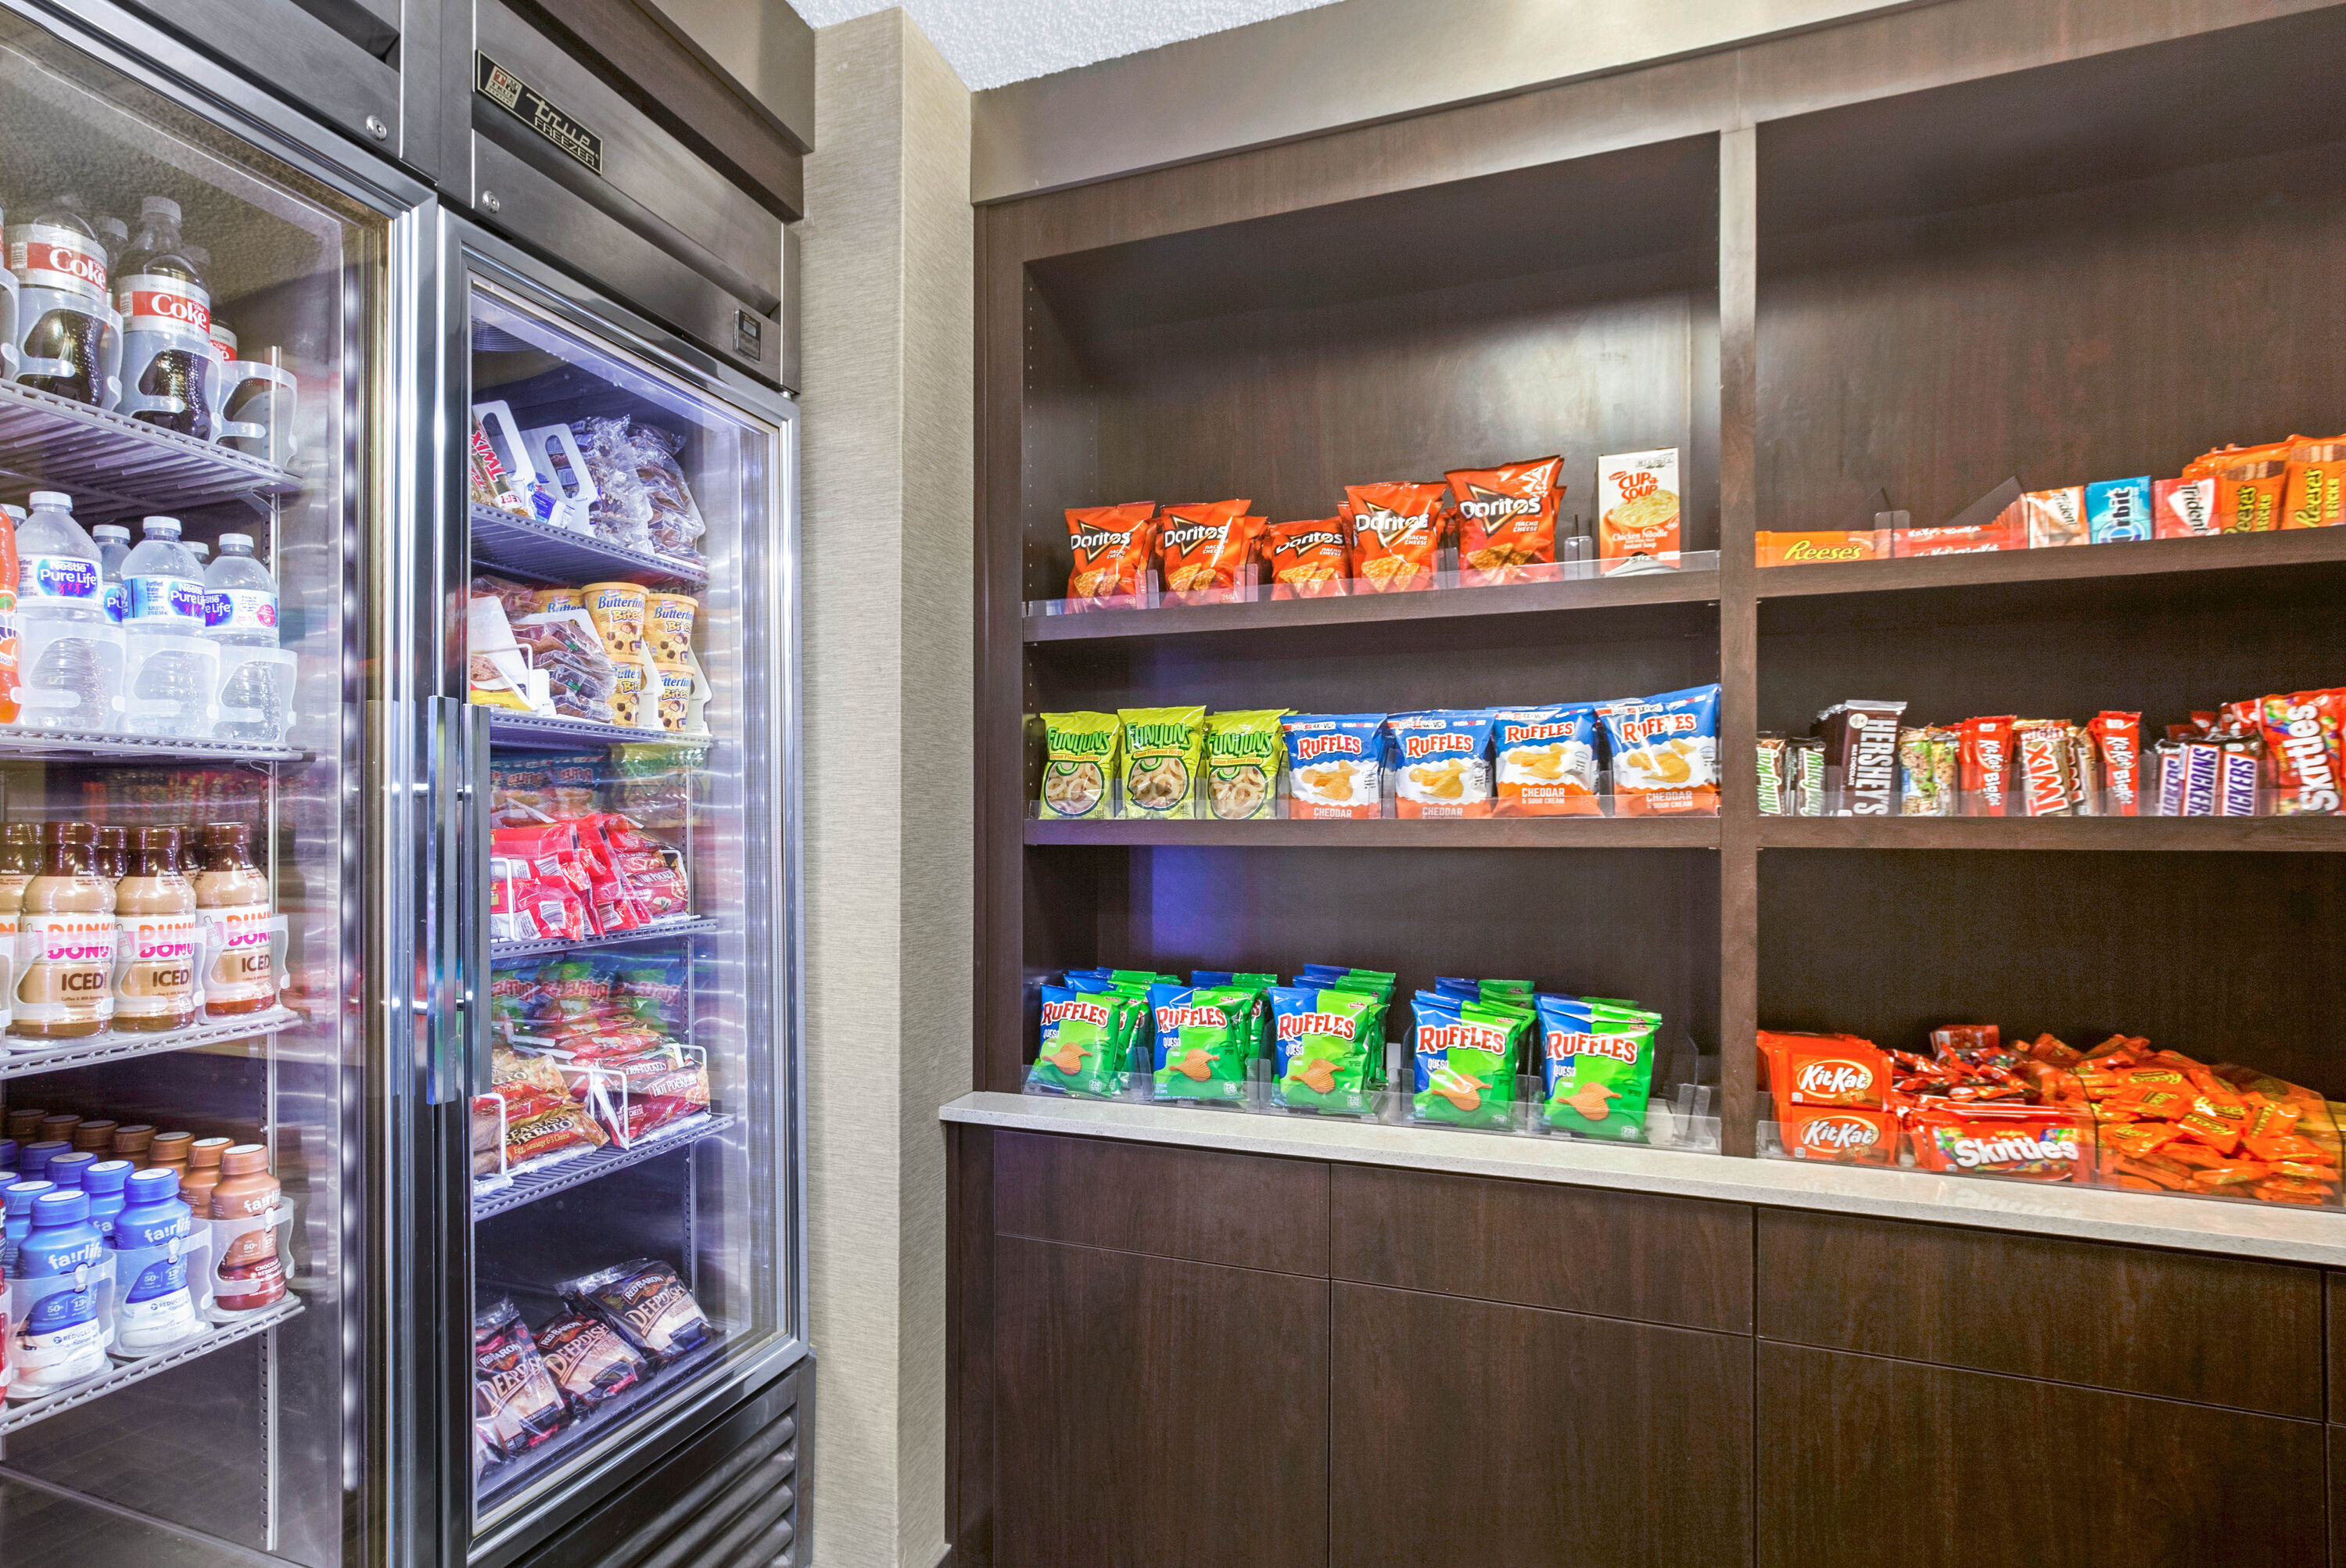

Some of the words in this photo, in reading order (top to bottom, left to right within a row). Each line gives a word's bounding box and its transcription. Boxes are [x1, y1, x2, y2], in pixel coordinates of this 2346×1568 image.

[534, 117, 594, 166] FREEZER
[50, 248, 106, 289] Coke
[151, 293, 207, 329] Coke
[471, 430, 507, 483] TWIX
[1618, 472, 1652, 490] CUP
[1621, 484, 1658, 504] SOUP
[1459, 496, 1541, 519] Doritos
[2054, 488, 2078, 526] Trident
[2179, 481, 2209, 534] Trident
[1355, 513, 1429, 533] Doritos
[1071, 531, 1131, 551] Doritos
[1164, 525, 1229, 548] Doritos
[1612, 533, 1641, 542] Chicken
[1642, 530, 1668, 540] Noodle
[1784, 540, 1864, 561] Reese's
[40, 569, 75, 583] Pure
[77, 572, 98, 589] Life
[170, 590, 196, 603] Pure
[598, 595, 645, 610] Butterfing
[212, 602, 231, 616] Life
[612, 609, 643, 624] Bites
[1507, 723, 1574, 742] RUFFLES
[1168, 748, 1183, 756] Rings
[1298, 736, 1361, 759] RUFFLES
[1407, 734, 1473, 758] RUFFLES
[1853, 719, 1898, 816] HERSHEY'S
[2285, 704, 2340, 812] Skittles
[1848, 755, 1857, 786] CHOCOLATE
[2023, 742, 2068, 816] TWIX
[2189, 748, 2218, 816] SNICKER
[1522, 788, 1565, 798] CHEDDAR
[1646, 791, 1692, 802] CHEDDAR
[1314, 807, 1352, 818] CHEDDAR
[1422, 806, 1463, 816] CHEDDAR
[242, 954, 271, 973] ICED
[61, 973, 104, 991] ICED
[152, 969, 189, 987] ICED
[1042, 1002, 1109, 1028] RUFFLES
[1156, 1007, 1228, 1032] RUFFLES
[1043, 1029, 1059, 1039] QUESO
[1279, 1014, 1355, 1039] RUFFLES
[1163, 1037, 1182, 1048] QUESO
[1419, 1025, 1505, 1053] RUFFLES
[1547, 1032, 1637, 1063] RUFFLES
[1286, 1045, 1304, 1056] QUESO
[1427, 1058, 1449, 1071] QUESO
[1553, 1064, 1576, 1077] QUESO
[507, 1118, 573, 1146] URRITO
[554, 1132, 572, 1143] Cheese
[1955, 1135, 2079, 1168] Skittles
[624, 1288, 639, 1301] RED
[636, 1275, 664, 1290] BARON
[540, 1332, 556, 1346] RED
[554, 1321, 583, 1336] BARON
[479, 1354, 493, 1367] RED
